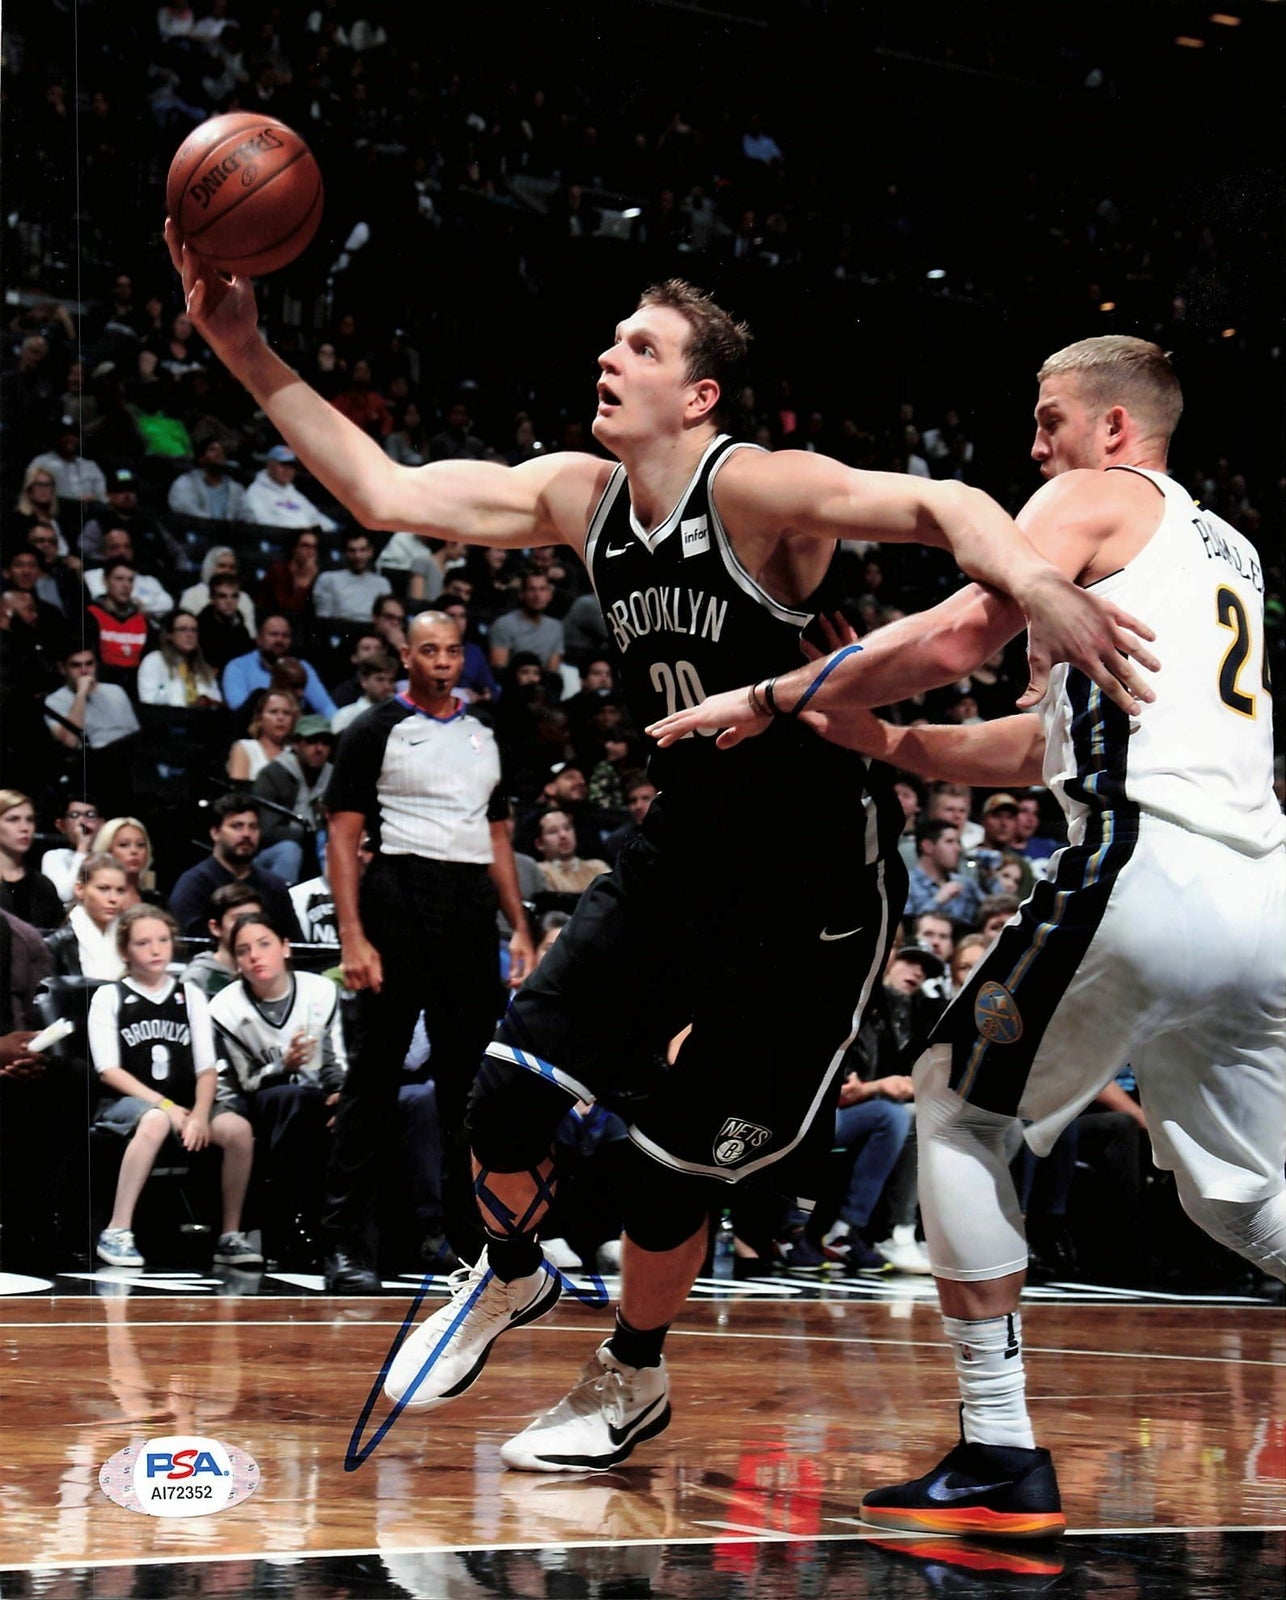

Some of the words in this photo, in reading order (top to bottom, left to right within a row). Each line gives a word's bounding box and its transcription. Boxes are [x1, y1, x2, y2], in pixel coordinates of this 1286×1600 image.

[684, 528, 708, 544] infor
[606, 586, 728, 654] BROOKLYN
[650, 660, 718, 739] 20
[120, 1019, 190, 1047] BROOKLYN
[720, 1121, 768, 1147] NETS
